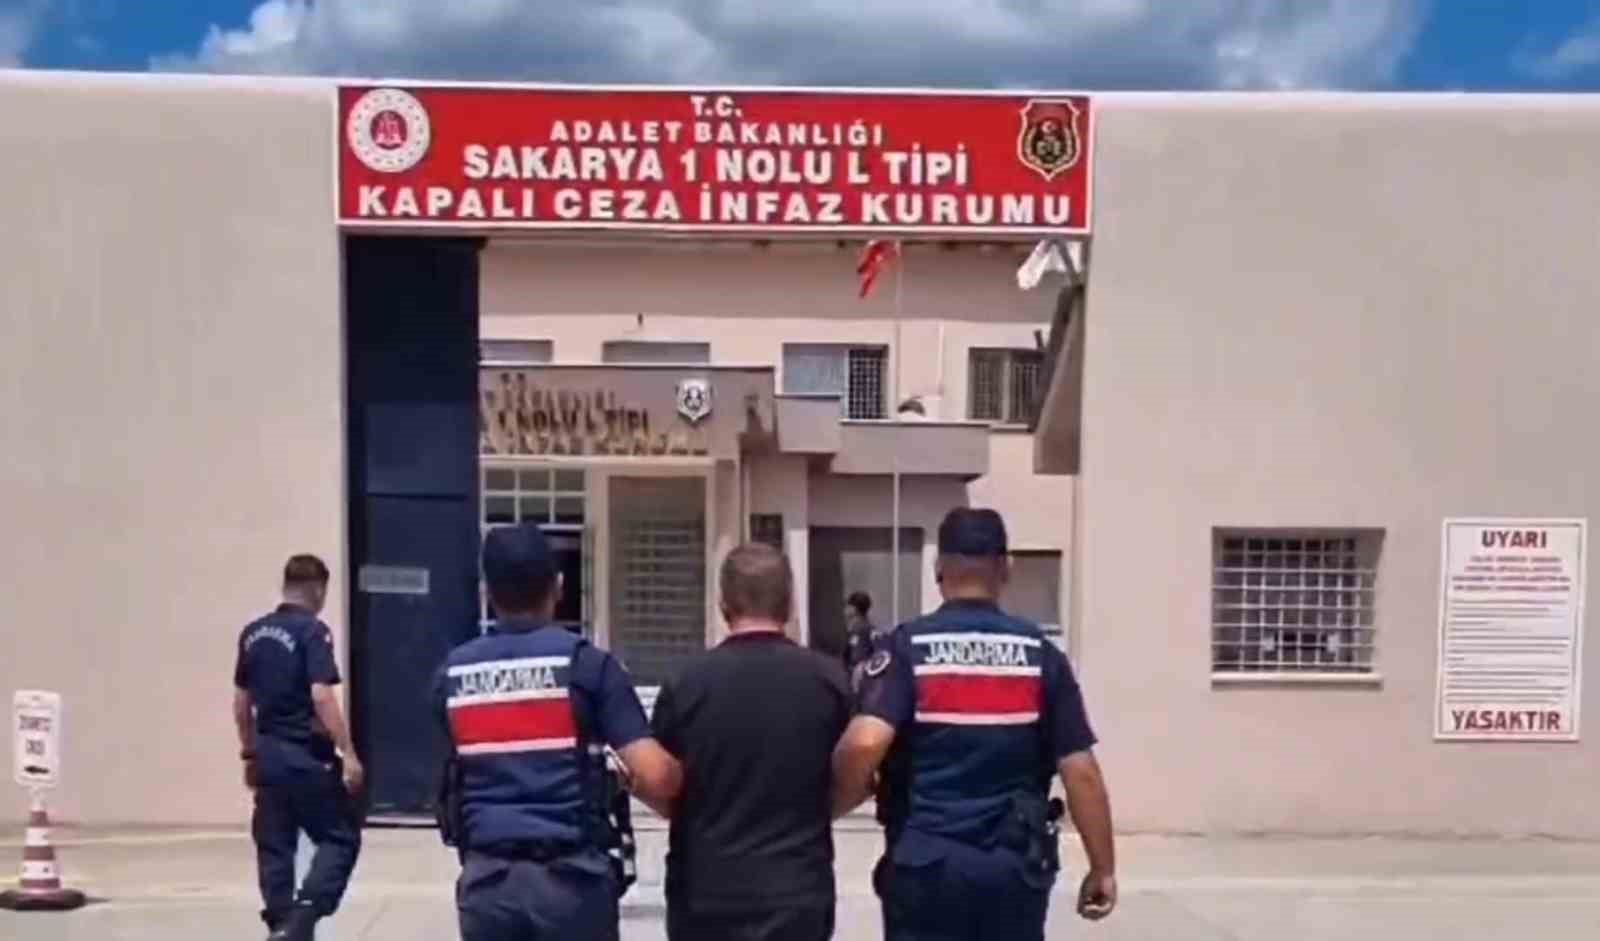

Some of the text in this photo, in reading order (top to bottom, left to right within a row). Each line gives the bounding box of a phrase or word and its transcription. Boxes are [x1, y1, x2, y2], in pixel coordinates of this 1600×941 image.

[691, 95, 743, 118] T.C.
[550, 119, 883, 146] ADALET BAKANLIĞI
[463, 143, 967, 185] SAKARYA 1 NOLU L TİPİ
[359, 183, 1072, 225] KAPALI CEZA İNFAZ KURUMU
[1482, 529, 1547, 549] UYARI
[924, 641, 1029, 665] JANDARMA
[1451, 709, 1561, 731] YASAKTIR
